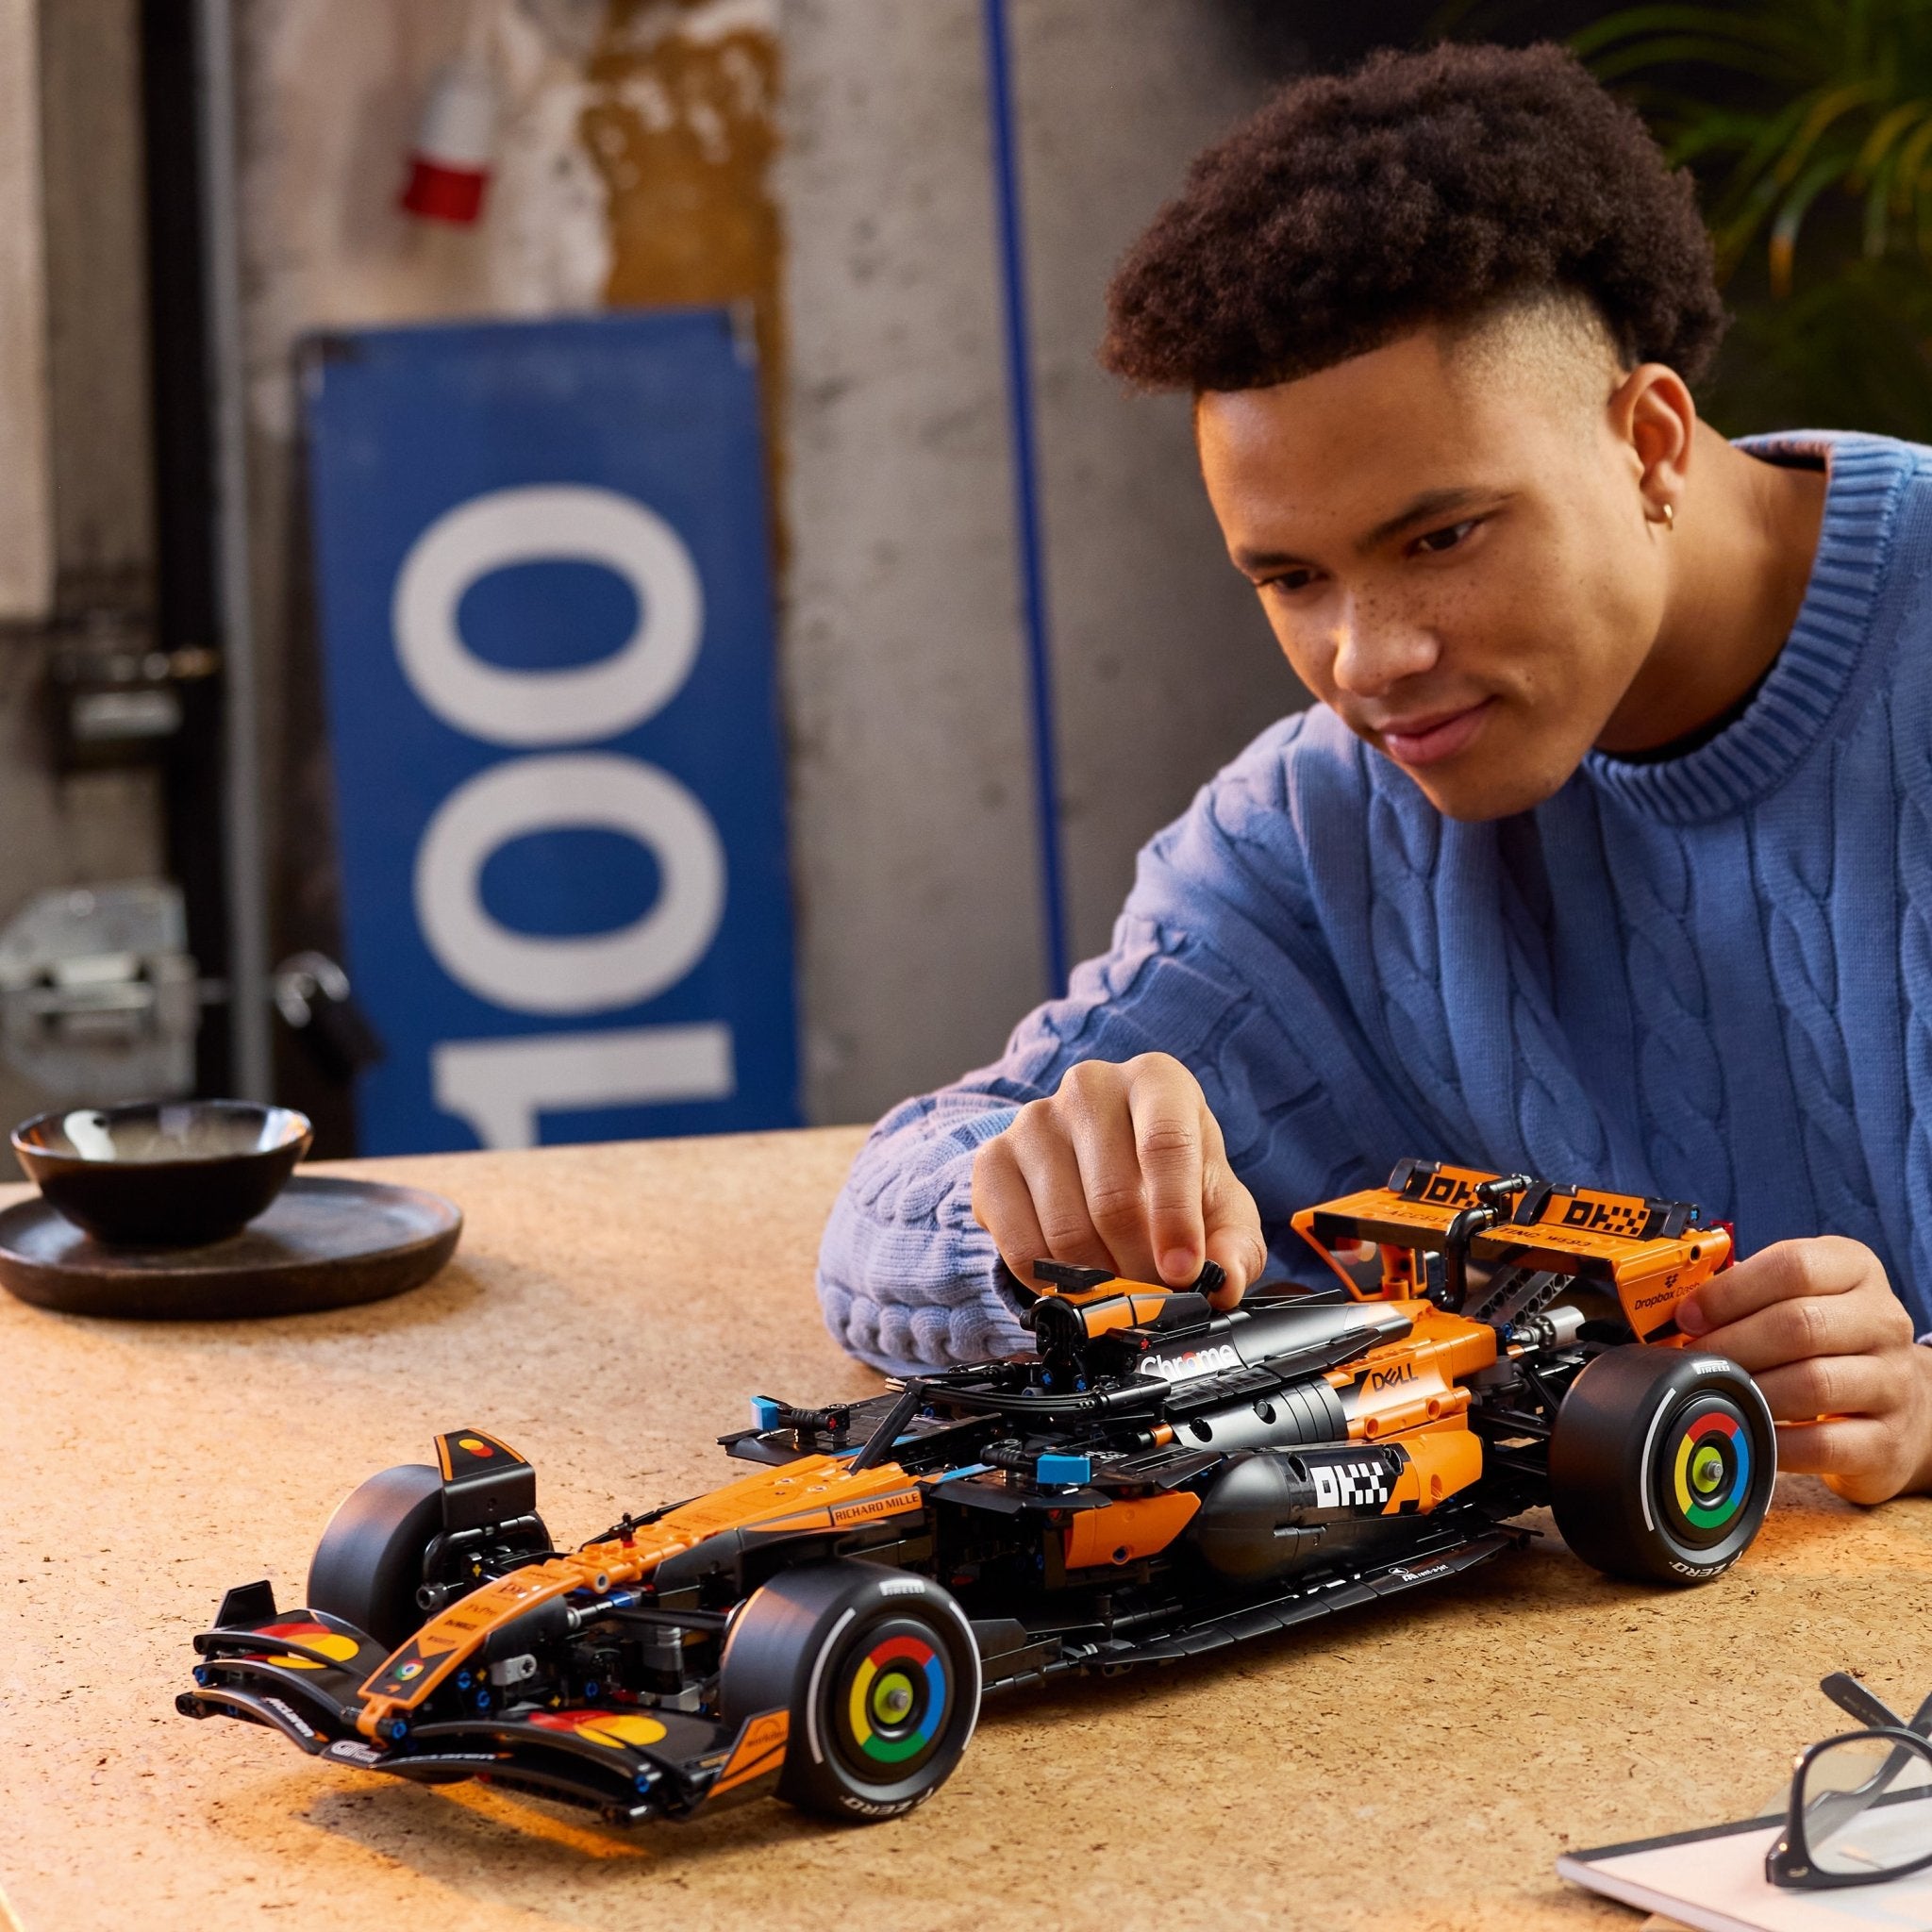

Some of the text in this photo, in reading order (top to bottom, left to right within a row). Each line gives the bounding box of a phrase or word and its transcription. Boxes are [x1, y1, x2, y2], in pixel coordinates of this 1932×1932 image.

[1561, 1200, 1648, 1235] OKX
[1634, 1291, 1675, 1310] Dropbox
[1141, 1344, 1236, 1382] Chrome
[1372, 1363, 1419, 1392] DELL
[1690, 1360, 1730, 1374] PIRELLI
[1309, 1462, 1388, 1508] OKX
[835, 1492, 919, 1522] RICHARD MILLE
[1672, 1561, 1727, 1577] ZERO
[844, 1796, 913, 1816] ZERO
